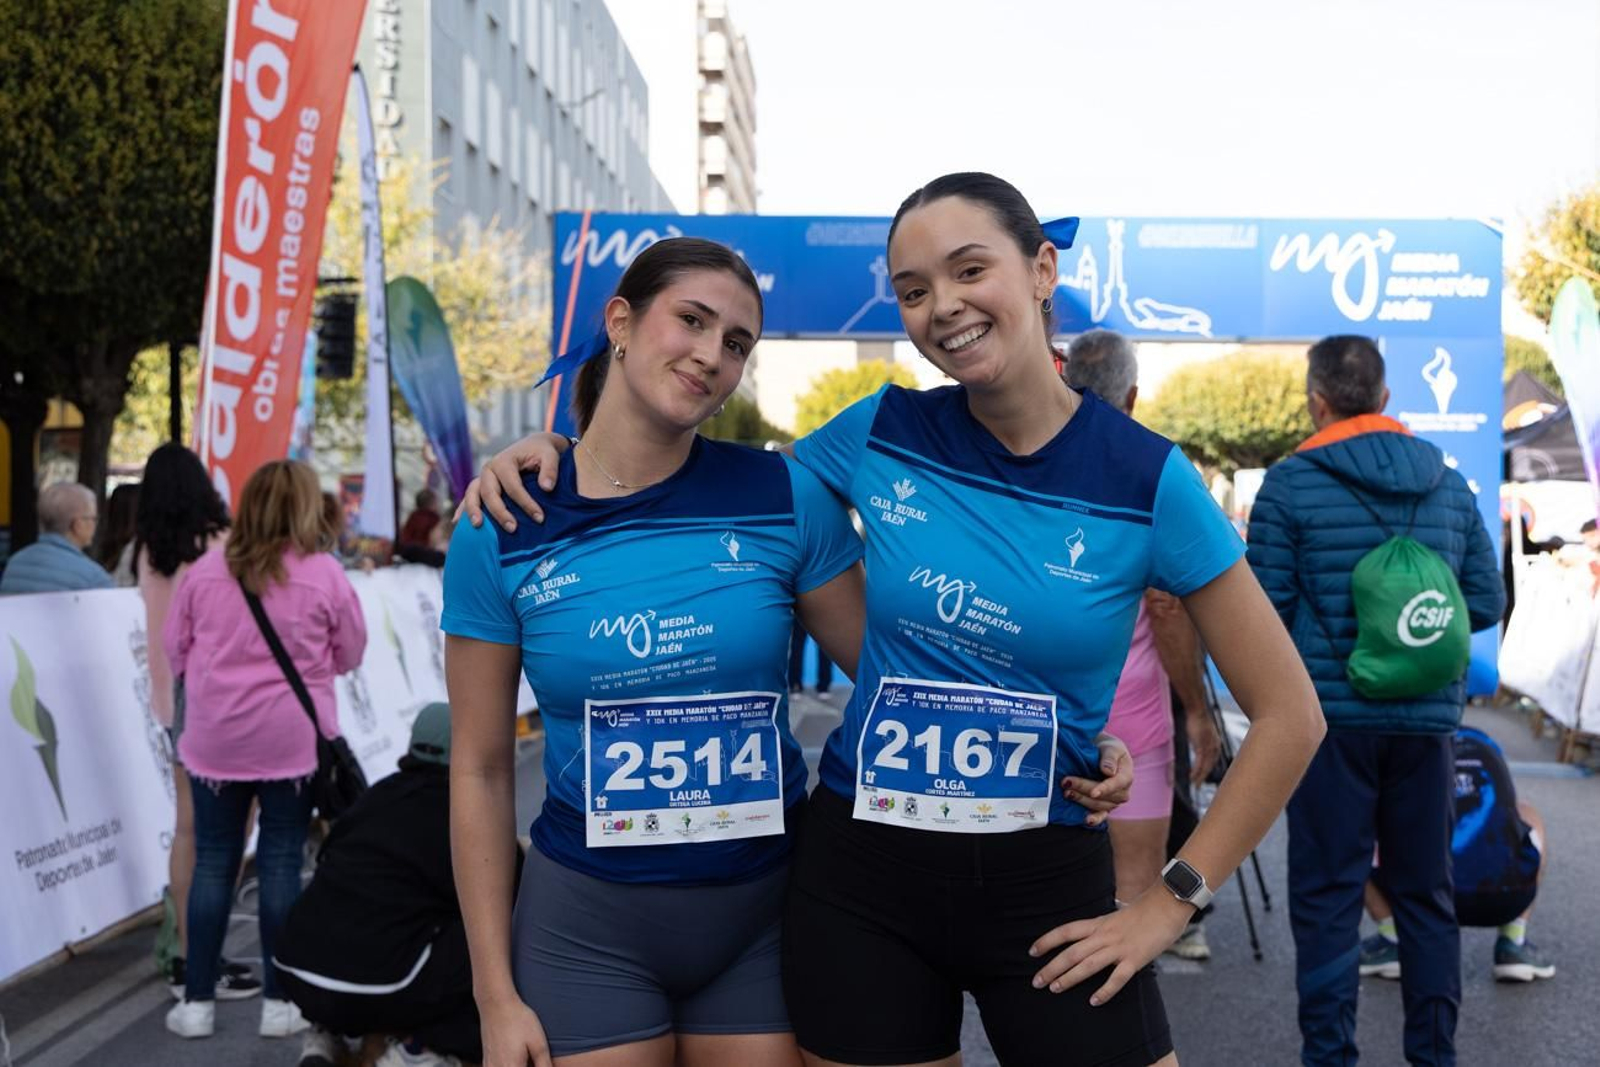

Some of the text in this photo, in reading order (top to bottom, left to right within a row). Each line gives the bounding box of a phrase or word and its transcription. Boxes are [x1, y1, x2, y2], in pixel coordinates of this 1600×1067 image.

[273, 107, 320, 298] maestras
[870, 495, 928, 523] CAJA RURAL
[881, 509, 907, 527] JAÉN
[543, 573, 580, 592] RURAL
[535, 588, 561, 606] JAÉN
[972, 596, 1009, 616] MEDIA
[659, 614, 695, 629] MEDIA
[965, 607, 1022, 635] MARATÓN
[1410, 606, 1454, 628] CSIF
[657, 624, 714, 642] MARATÓN
[958, 619, 988, 636] JAÉN
[655, 643, 683, 656] JAÉN
[928, 693, 949, 702] MEDIA
[664, 708, 685, 716] MEDIA
[686, 705, 717, 715] MARATÓN
[932, 702, 942, 710] EN
[944, 703, 974, 712] MEMORIA
[990, 707, 1006, 715] PACO
[669, 716, 678, 724] EN
[681, 715, 708, 723] MEMORIA
[874, 719, 1039, 778] 2167
[604, 732, 767, 791] 2514
[934, 778, 967, 791] OLGA
[669, 789, 711, 802] LAURA
